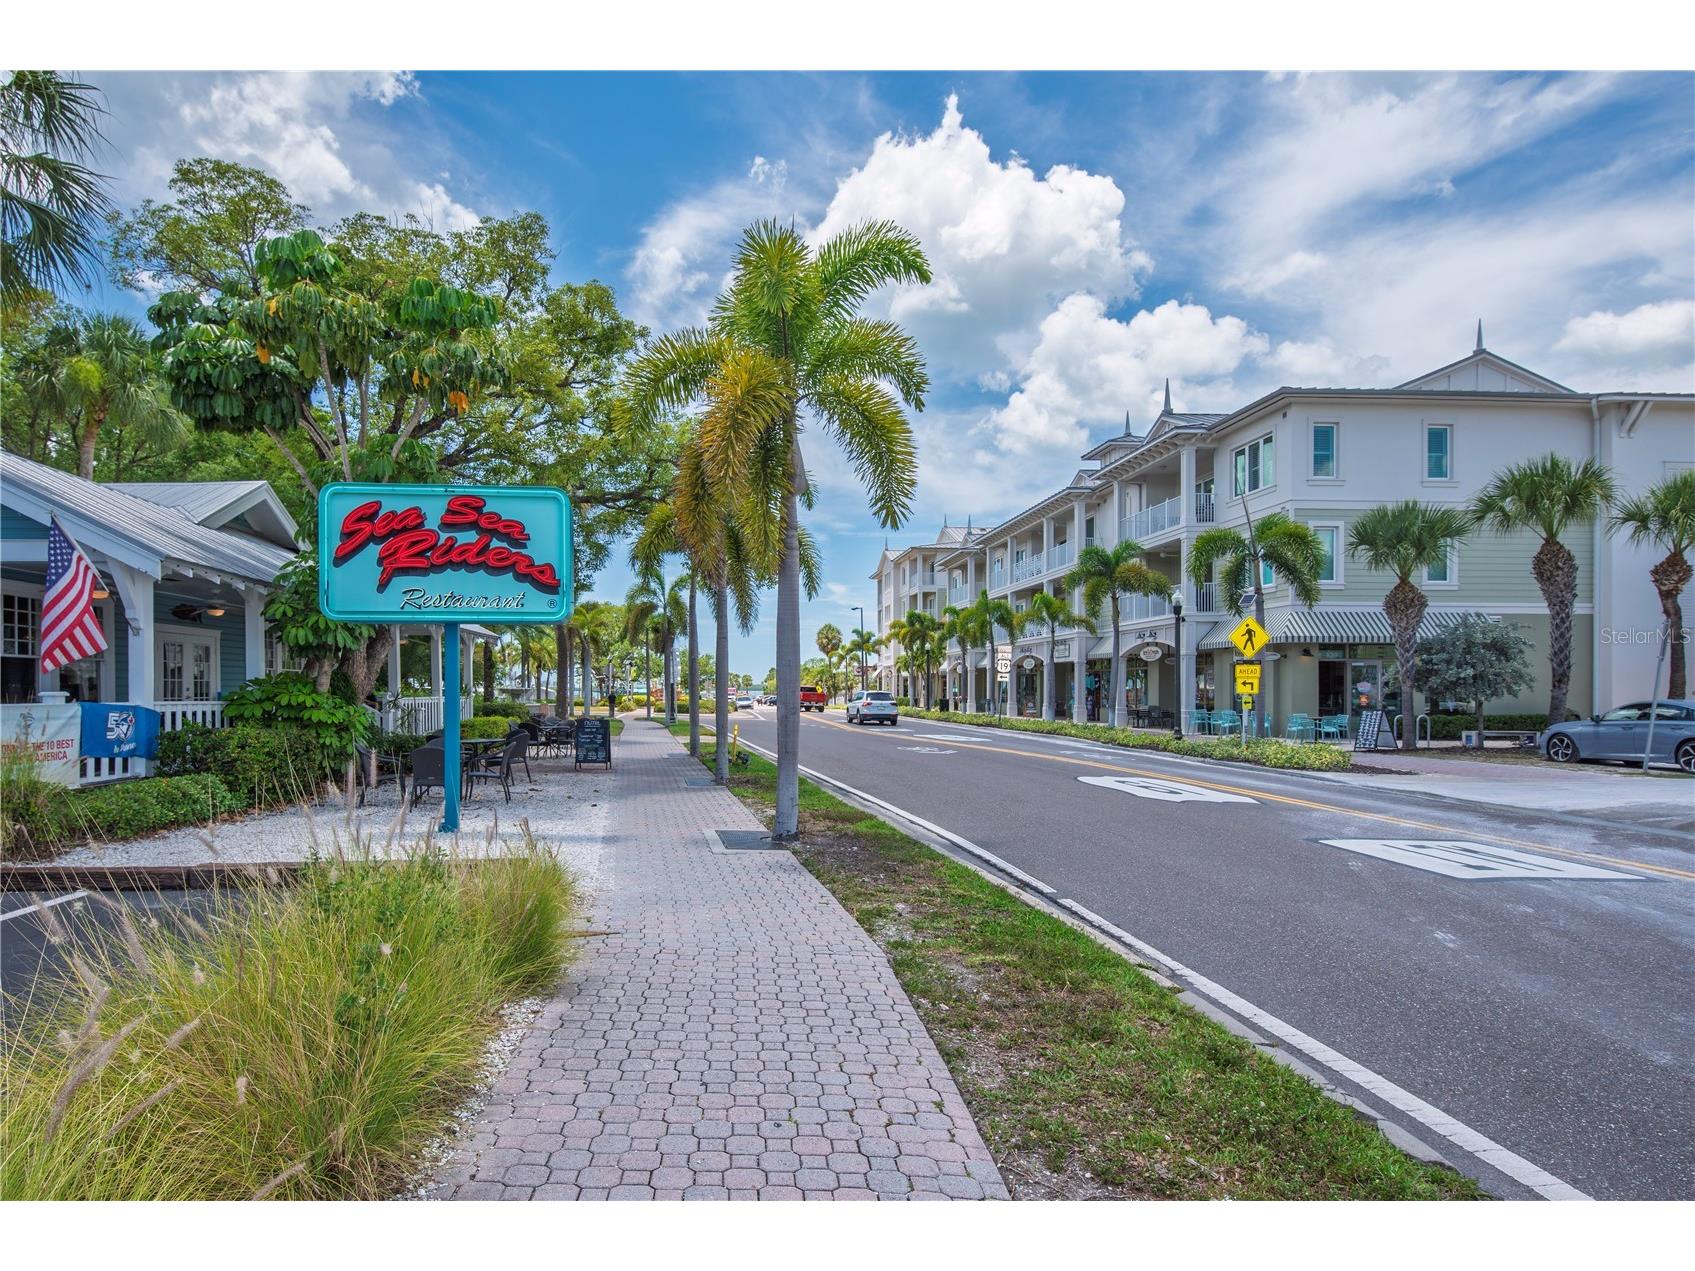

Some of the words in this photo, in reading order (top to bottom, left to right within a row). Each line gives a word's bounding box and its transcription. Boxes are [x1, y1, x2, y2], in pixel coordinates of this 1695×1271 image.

[335, 500, 426, 560] Sea
[440, 495, 530, 542] Sea
[378, 528, 560, 587] Riders
[400, 587, 525, 610] Restaurant
[1000, 662, 1009, 670] 19
[31, 741, 46, 751] THE
[46, 740, 55, 750] 10
[56, 739, 75, 749] BEST
[35, 751, 68, 761] AMERICA
